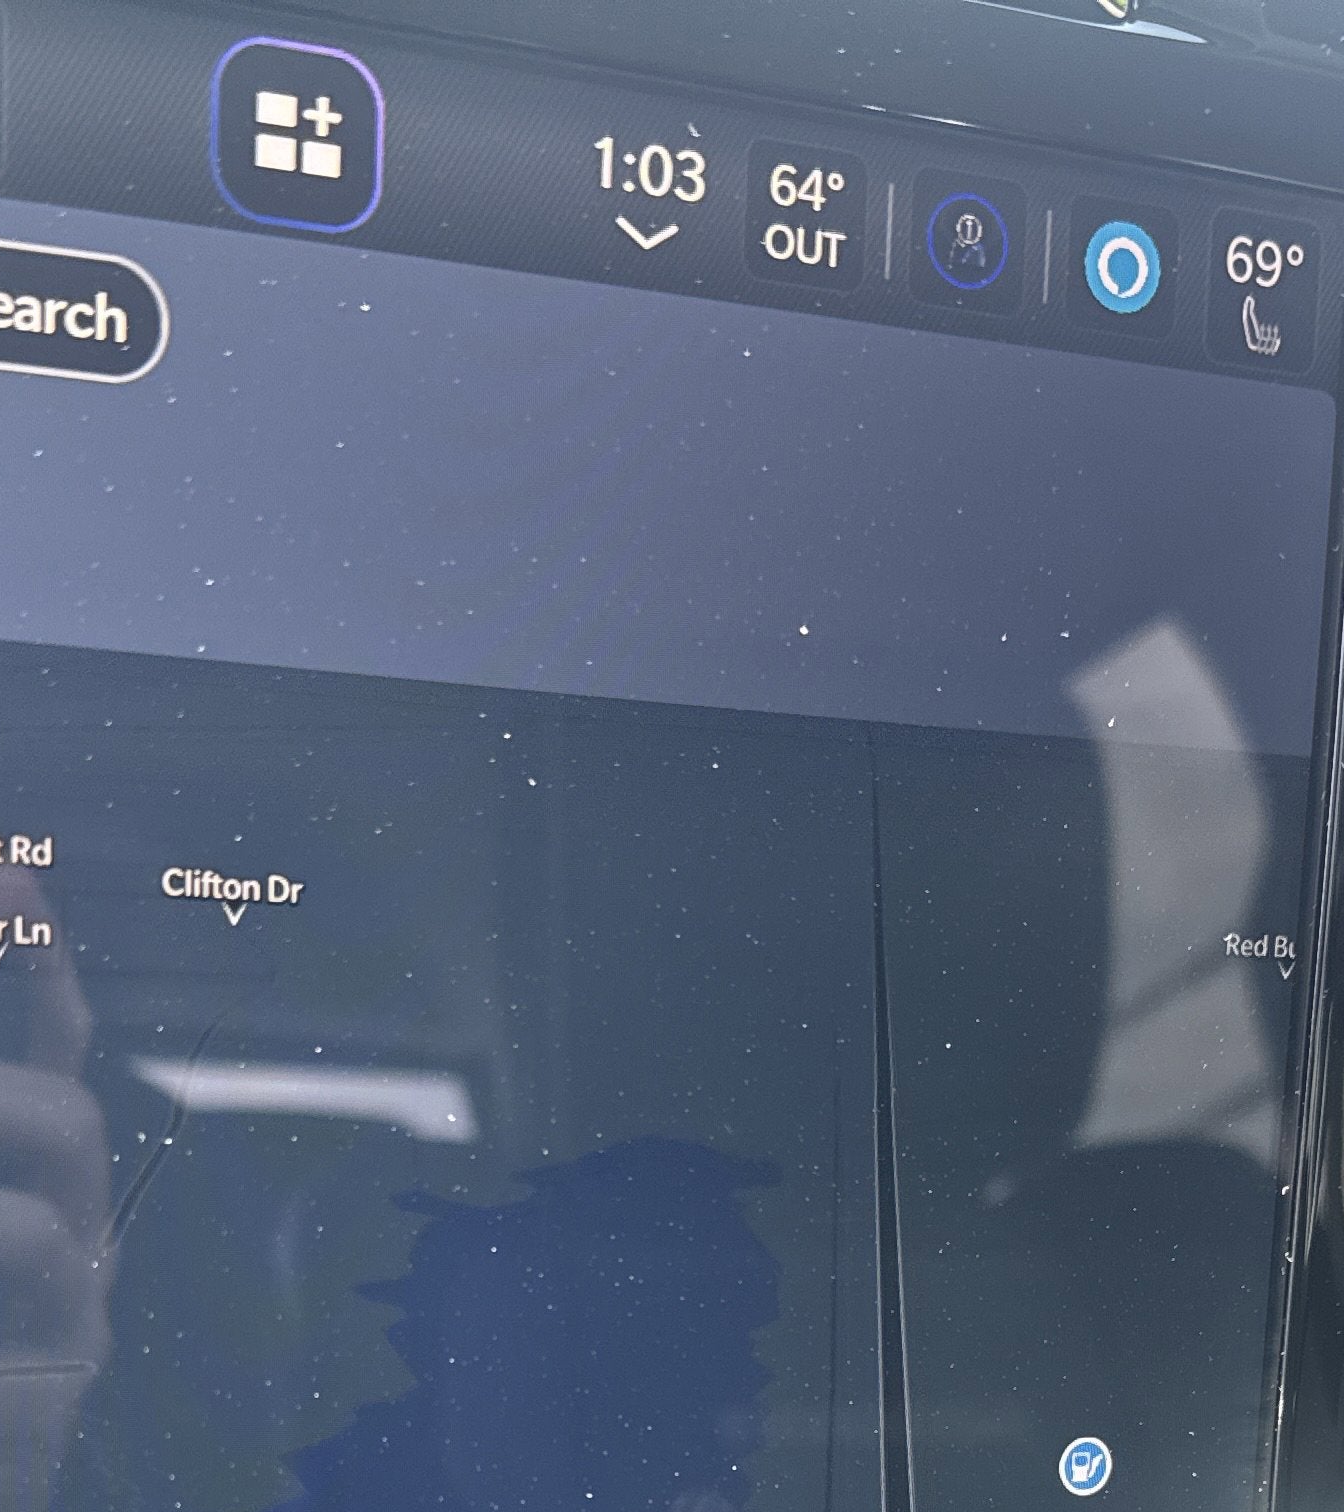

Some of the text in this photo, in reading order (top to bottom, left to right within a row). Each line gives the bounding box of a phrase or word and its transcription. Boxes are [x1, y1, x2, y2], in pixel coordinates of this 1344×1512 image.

[593, 136, 707, 203] 1:03
[769, 163, 846, 212] 64°
[764, 223, 848, 269] OUT
[1225, 235, 1305, 288] 69°
[10, 835, 53, 868] Rd
[161, 867, 304, 904] Clifton Dr
[14, 916, 52, 946] Ln
[1224, 932, 1269, 958] Red
